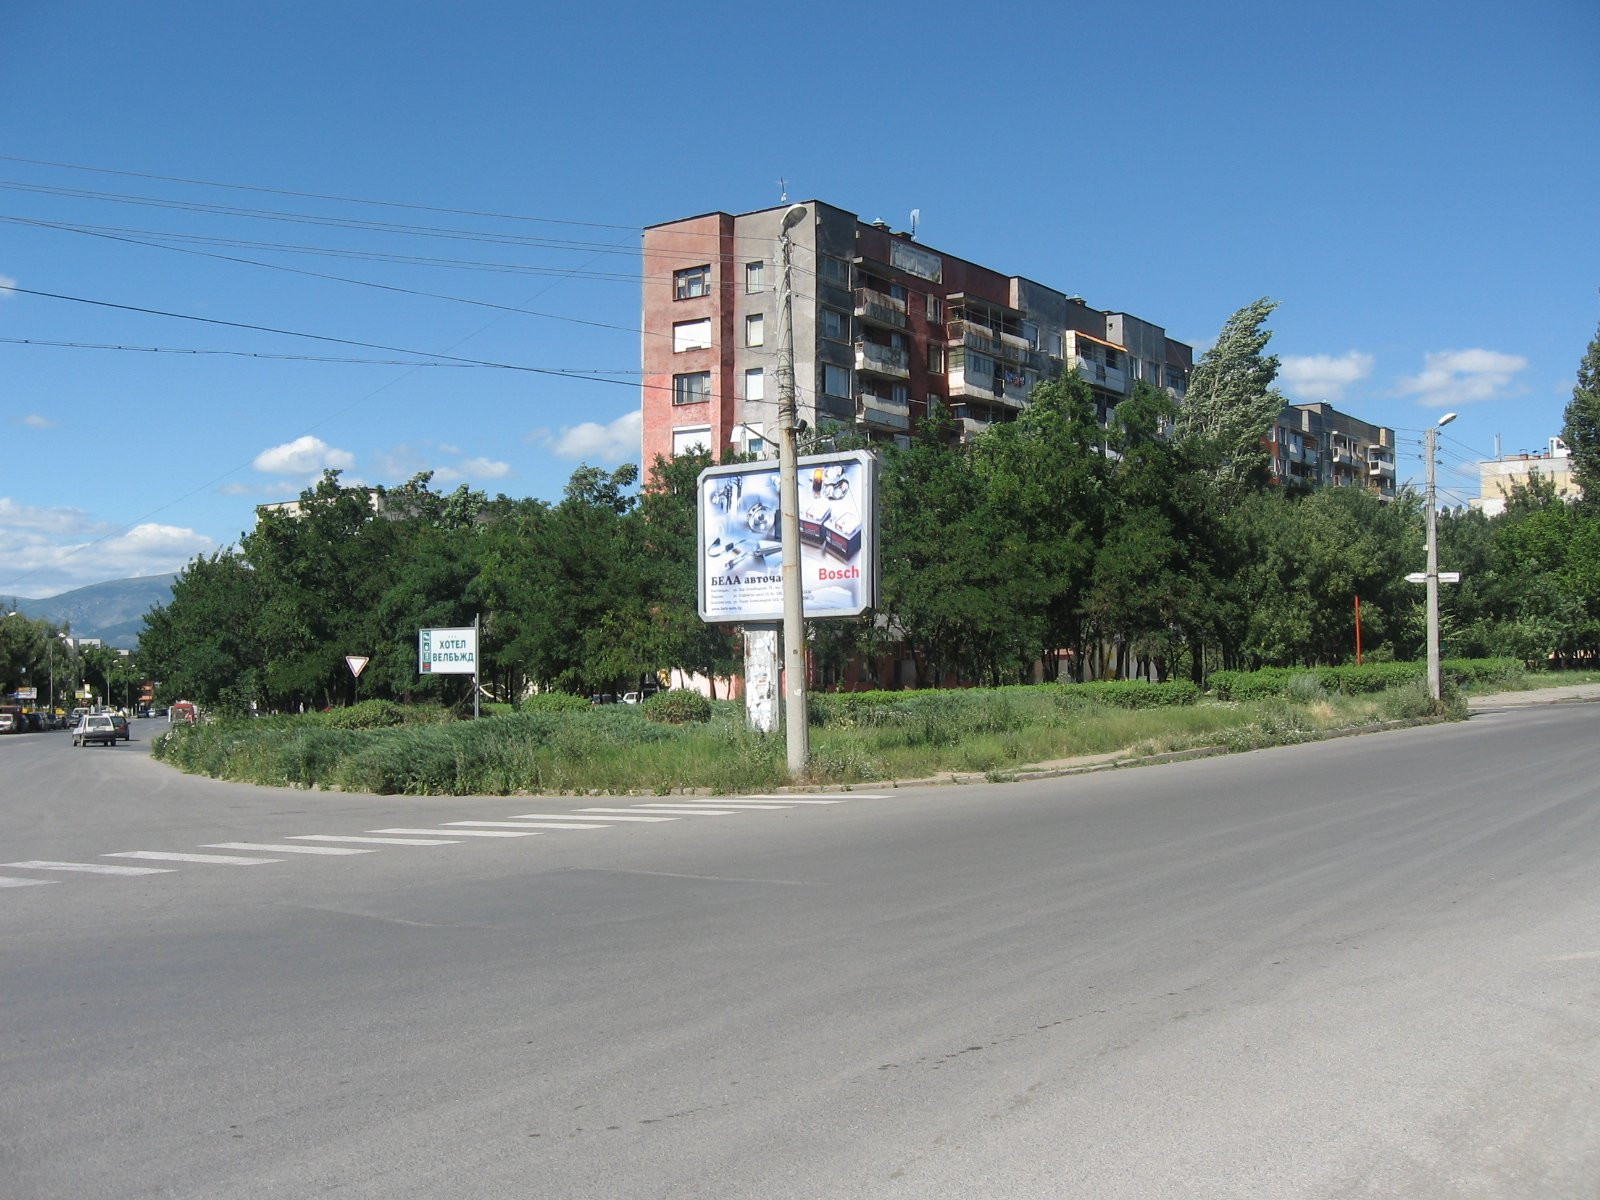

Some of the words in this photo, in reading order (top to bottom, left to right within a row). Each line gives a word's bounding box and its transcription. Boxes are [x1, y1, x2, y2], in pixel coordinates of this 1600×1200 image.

[818, 565, 859, 581] Bosch
[711, 574, 741, 586] БЕЛА
[439, 640, 466, 649] ХОТЕЛ
[432, 652, 474, 663] ВЕЛБЪЖД
